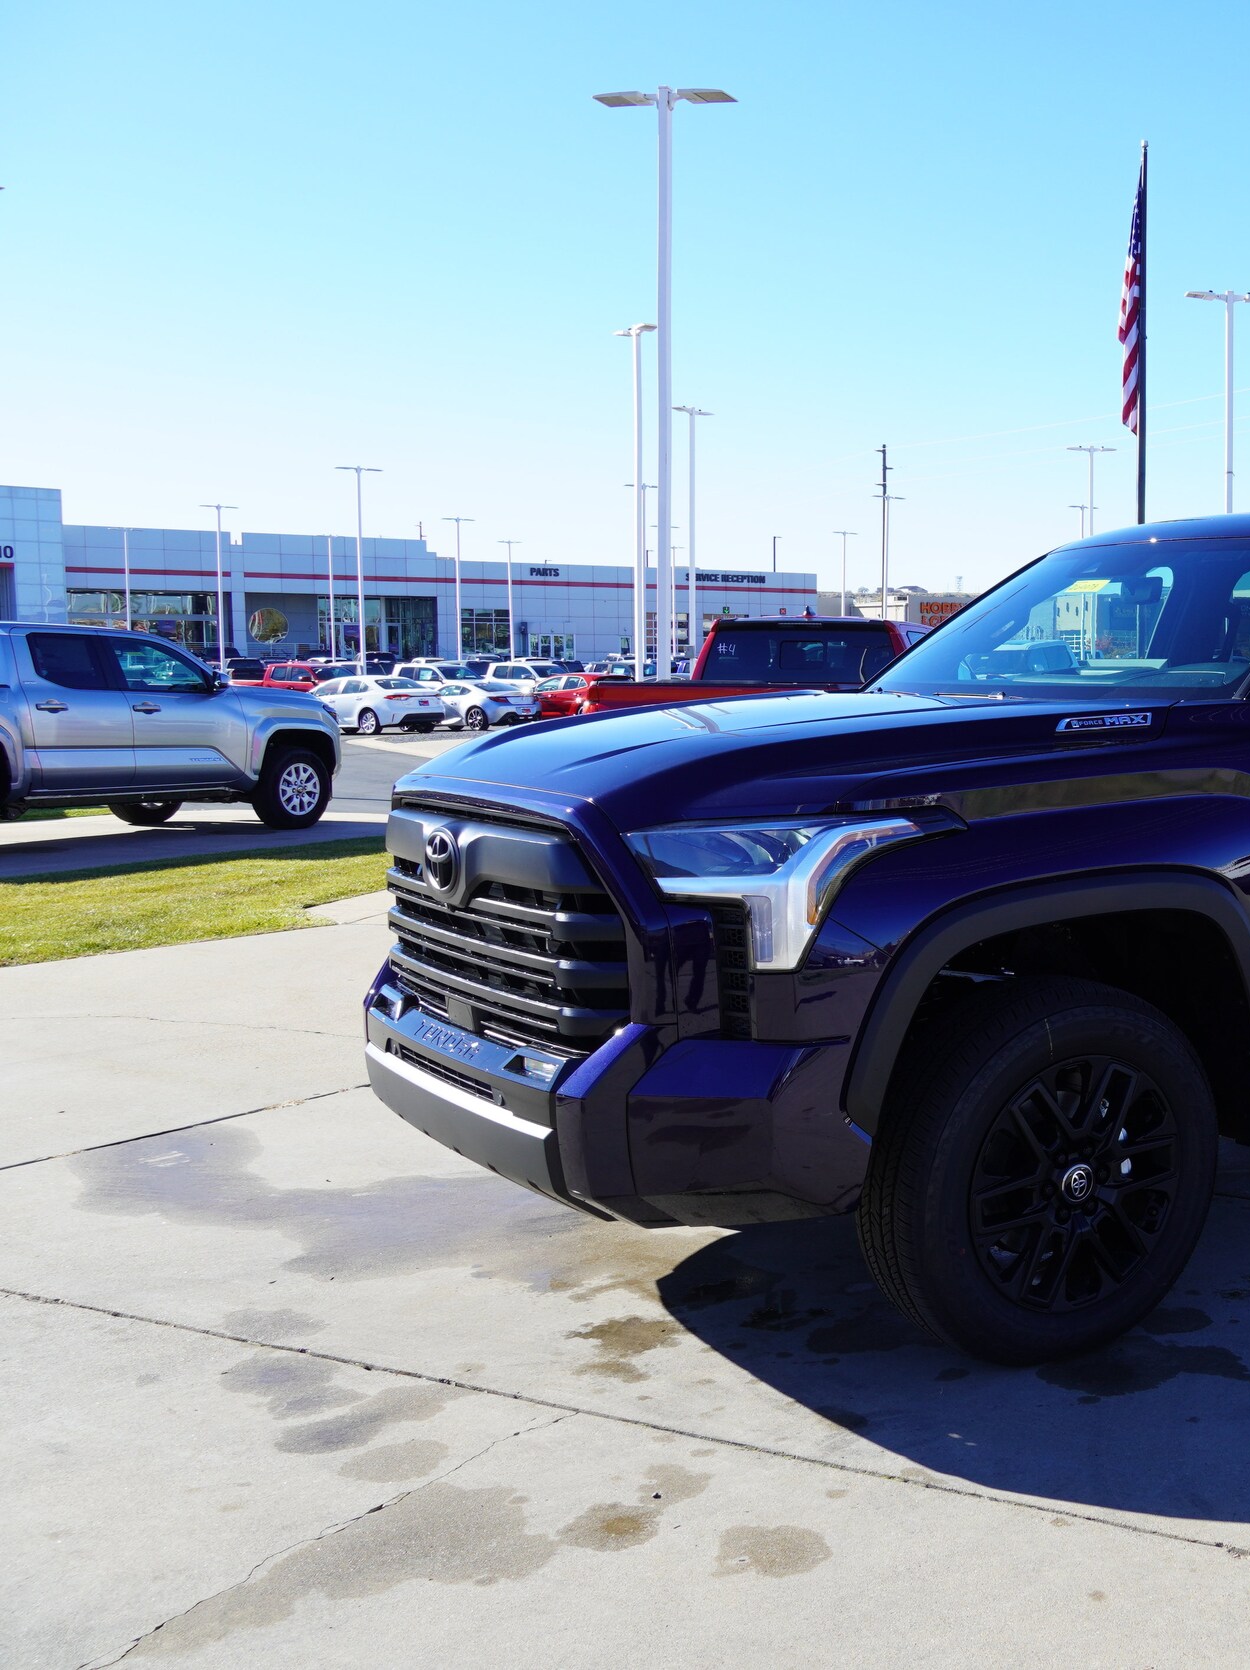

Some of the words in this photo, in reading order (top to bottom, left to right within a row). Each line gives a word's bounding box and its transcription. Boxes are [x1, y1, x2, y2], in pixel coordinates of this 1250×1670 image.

[530, 567, 560, 577] PARTS
[686, 573, 719, 582] SRVICE
[721, 574, 766, 584] RECEPTION
[717, 643, 736, 656] #4
[1103, 715, 1146, 726] MAX
[413, 1019, 481, 1060] TUNDRA
